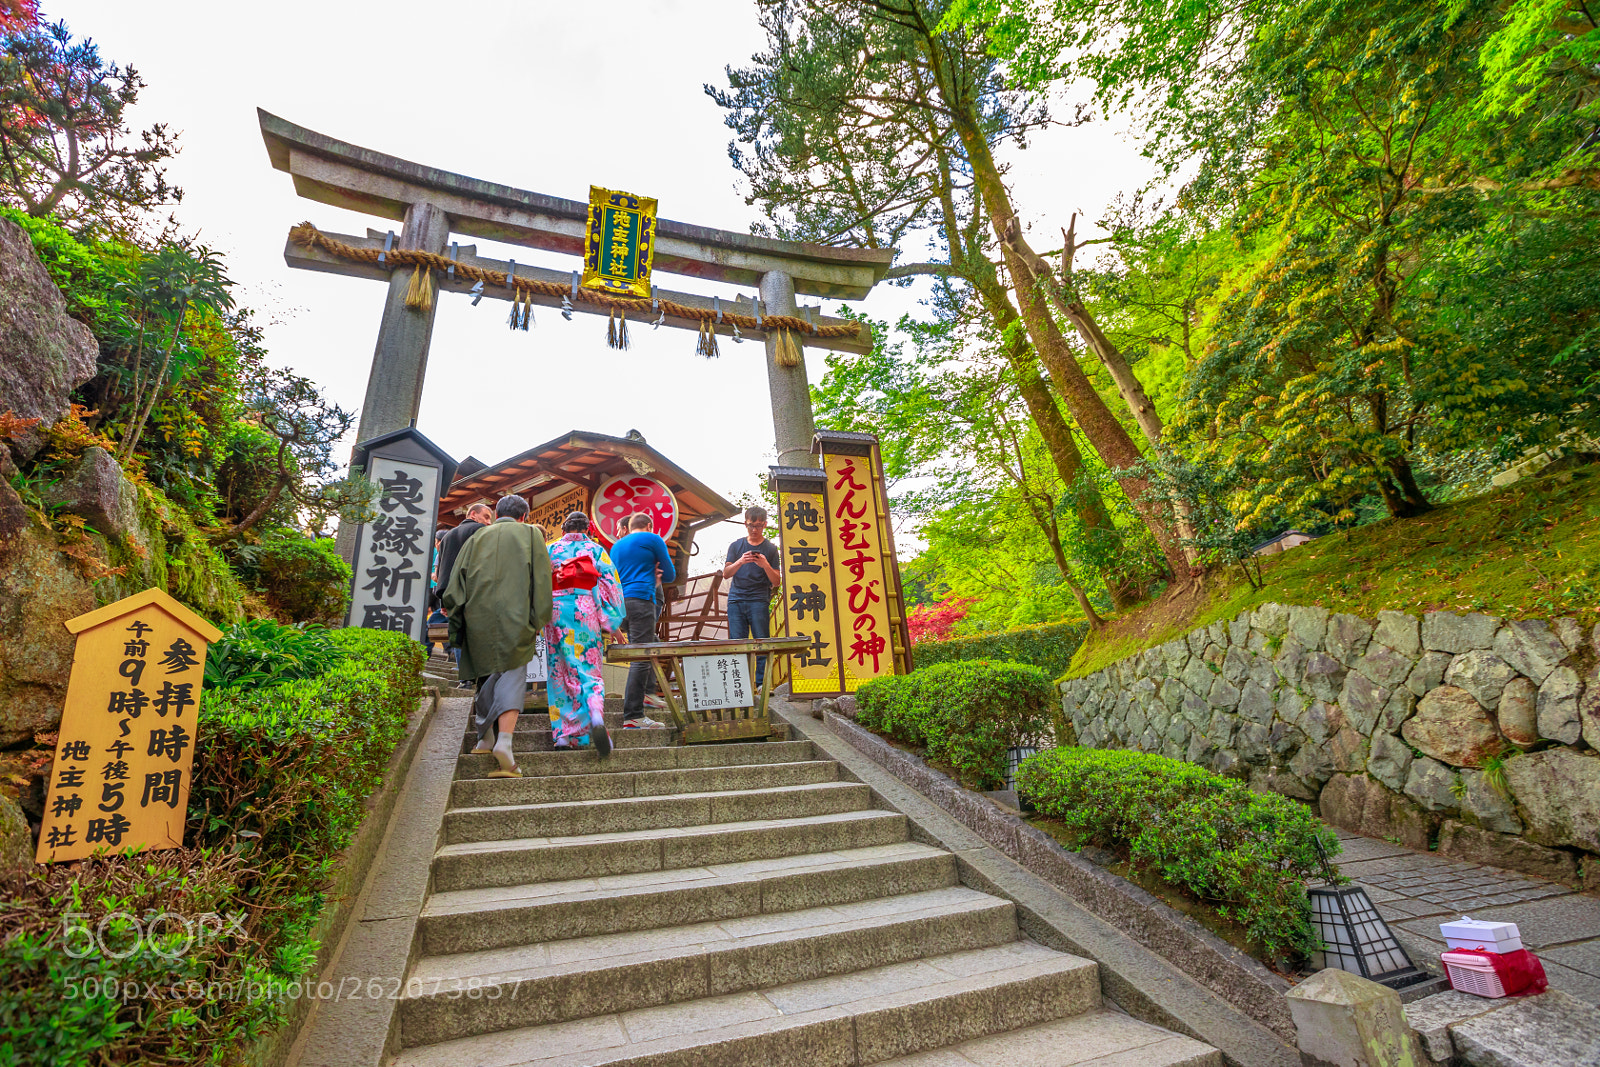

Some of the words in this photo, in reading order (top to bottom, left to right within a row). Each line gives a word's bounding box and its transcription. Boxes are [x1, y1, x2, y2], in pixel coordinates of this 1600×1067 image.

[609, 211, 631, 276] 地主神社
[361, 470, 426, 635] 良縁祈願
[562, 488, 584, 505] SHRINE
[784, 500, 832, 668] 地主神社
[834, 459, 886, 673] えんむすびの神
[140, 638, 200, 809] 参拝時間
[701, 698, 722, 707] CLOSED
[45, 740, 91, 849] 地主神社
